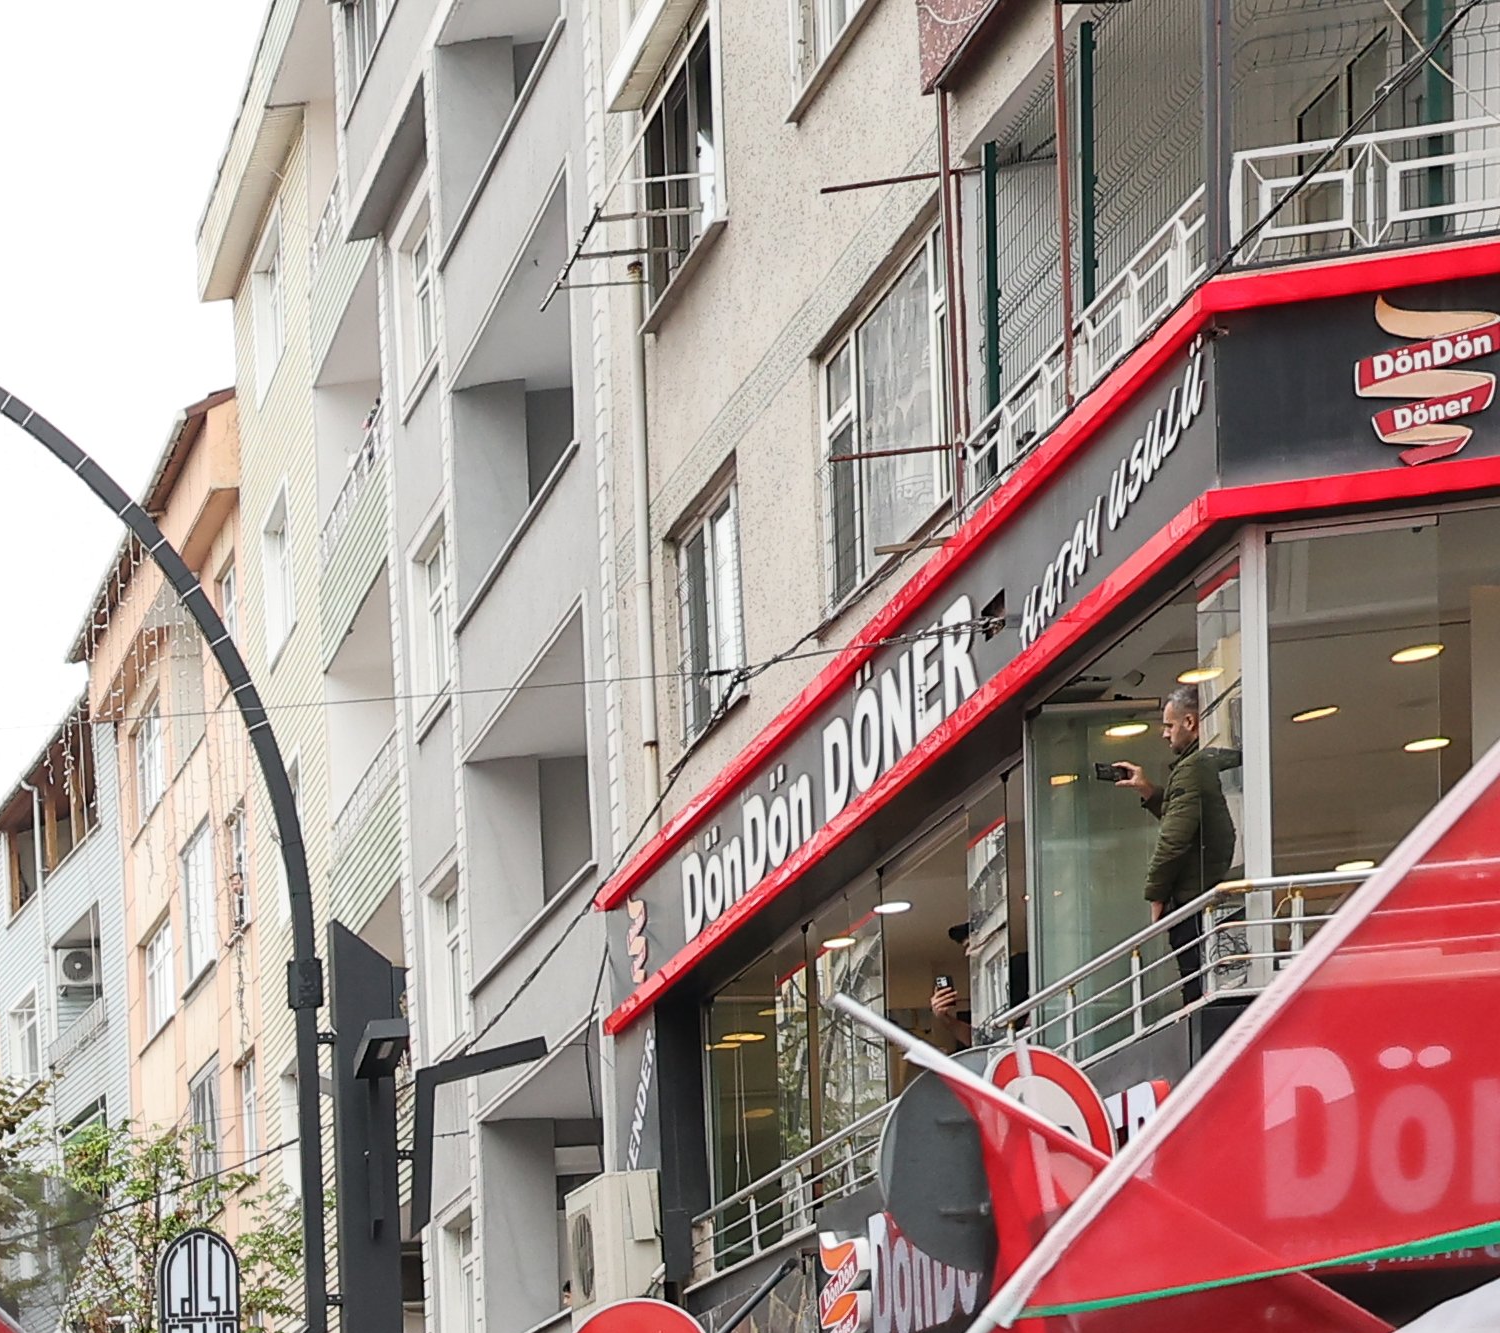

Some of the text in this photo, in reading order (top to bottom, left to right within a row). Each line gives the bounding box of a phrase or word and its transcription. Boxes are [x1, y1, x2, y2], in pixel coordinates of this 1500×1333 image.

[1372, 334, 1492, 380] DönDön
[1393, 396, 1473, 430] Döner
[1020, 333, 1205, 651] HATAY USULÜ
[681, 594, 979, 945] DönDön DÖNER
[627, 1027, 655, 1171] ENDER
